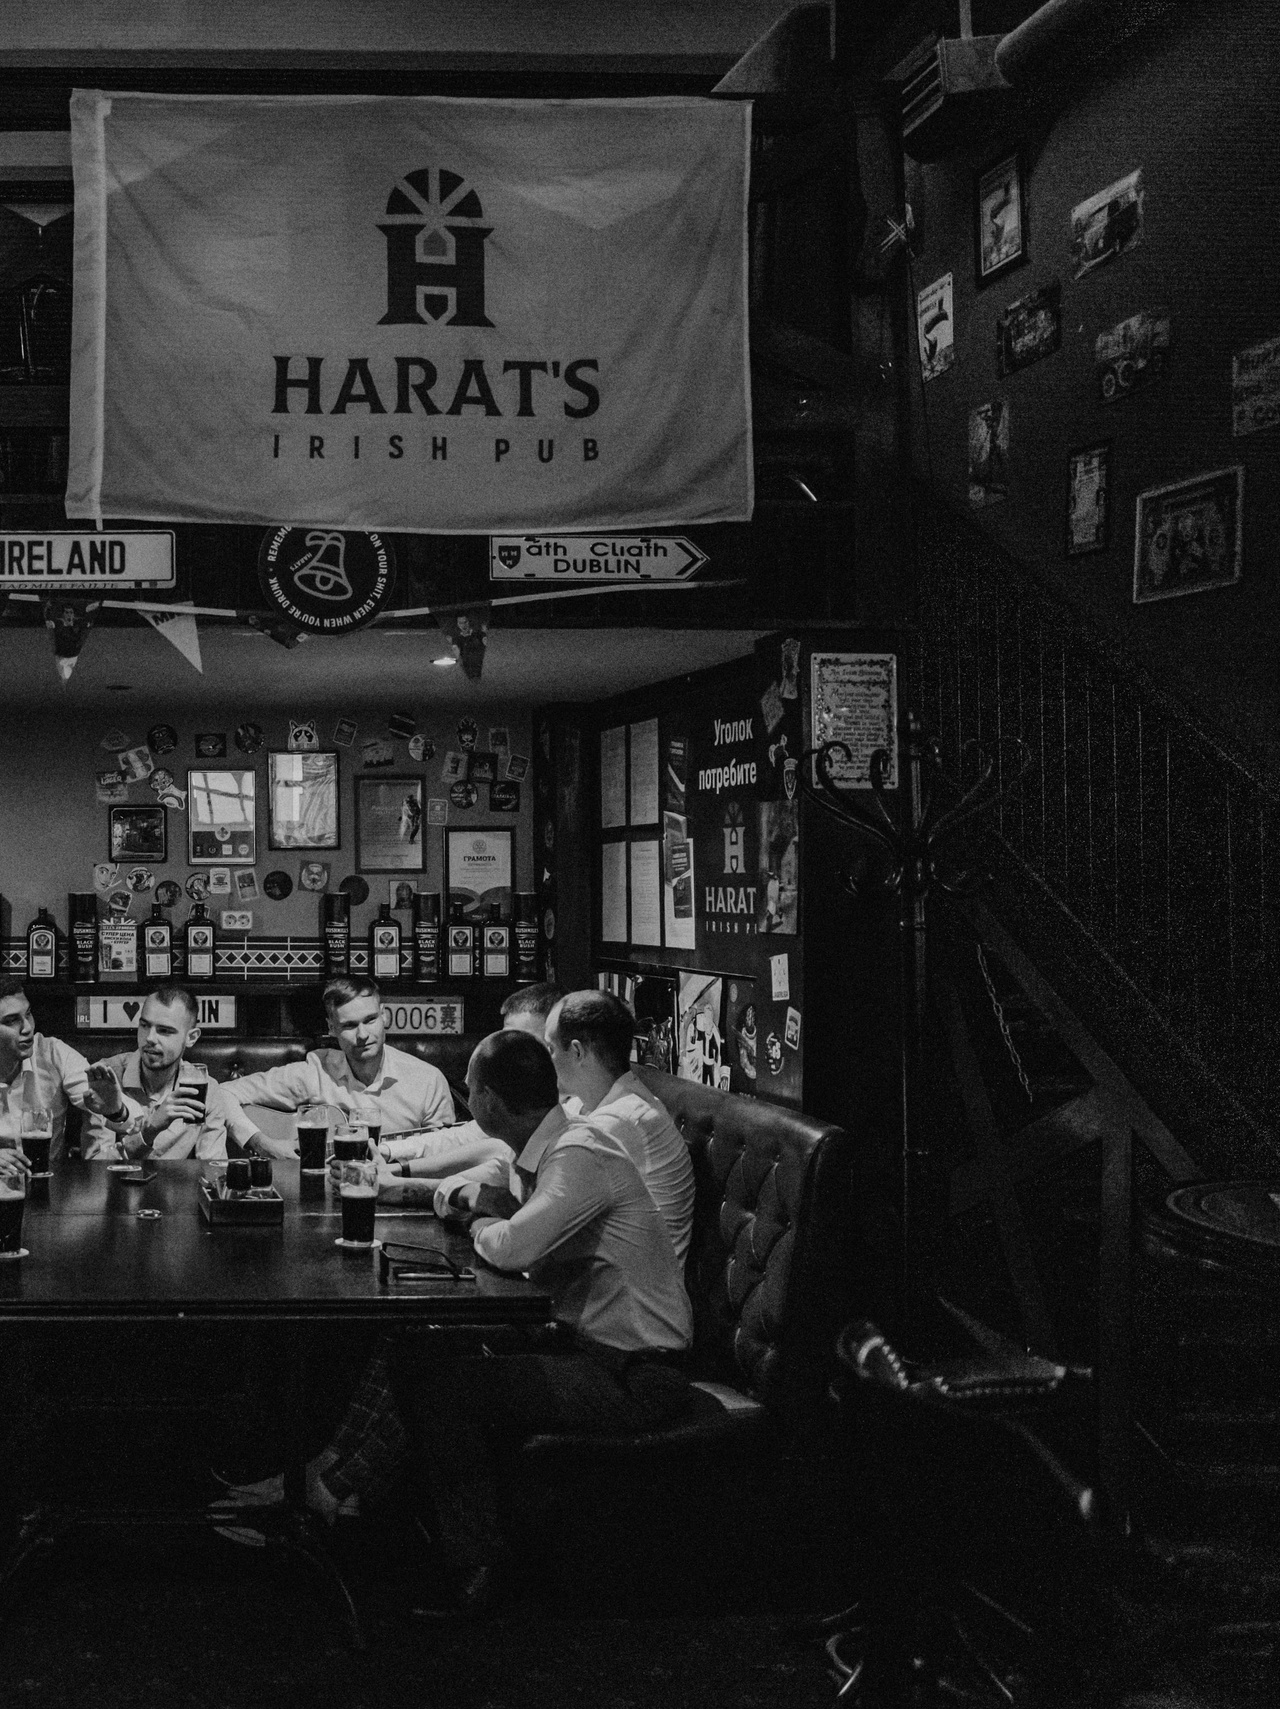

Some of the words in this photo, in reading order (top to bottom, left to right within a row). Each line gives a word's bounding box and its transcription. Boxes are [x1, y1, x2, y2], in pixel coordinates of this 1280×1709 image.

[271, 355, 601, 419] HARAT'S
[273, 434, 448, 461] IRISH
[494, 438, 600, 464] PUB
[369, 533, 383, 548] ON
[376, 548, 388, 575] YOUR
[553, 558, 641, 574] DUBLIN
[268, 577, 291, 609] DRUNK
[287, 605, 321, 627] YOU'RE
[323, 615, 354, 628] WHEN
[353, 599, 376, 620] EVEN
[713, 717, 754, 746] Уголок
[705, 886, 758, 915] HARAT
[103, 1000, 108, 1024] I
